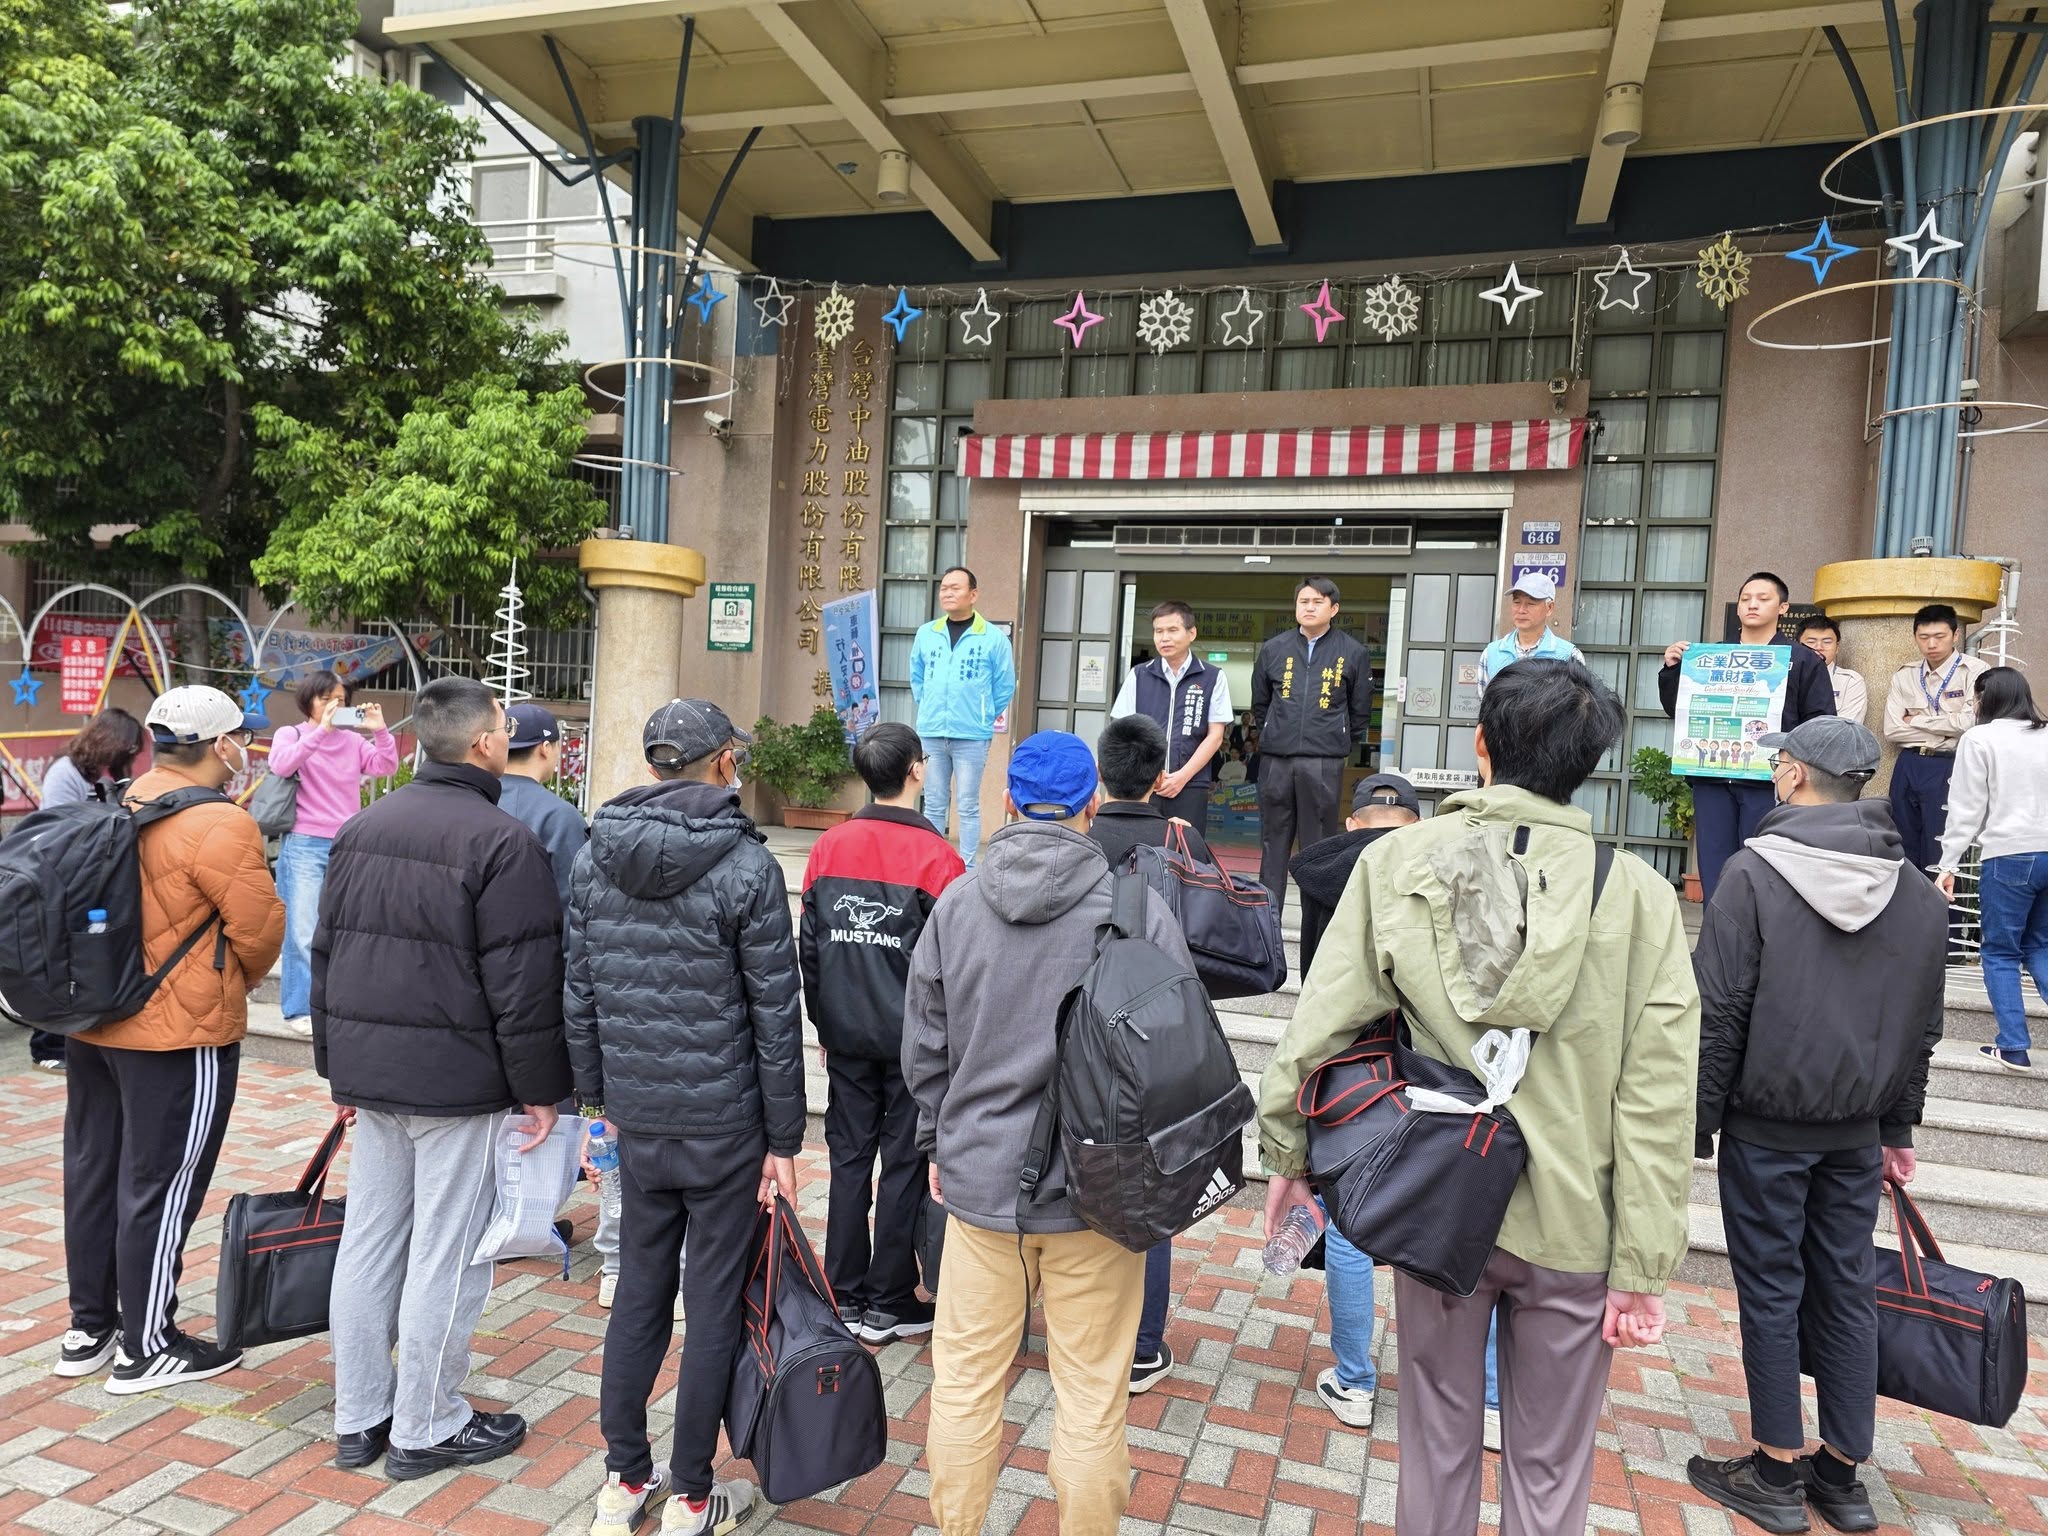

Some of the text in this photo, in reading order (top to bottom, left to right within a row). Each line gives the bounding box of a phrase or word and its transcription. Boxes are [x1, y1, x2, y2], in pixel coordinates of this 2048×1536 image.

[839, 340, 875, 591] 台灣中油股份有限
[1527, 531, 1554, 545] 646
[1696, 651, 1774, 670] 企業反毒
[830, 928, 902, 949] MUSTANG
[1192, 1183, 1237, 1219] adidas
